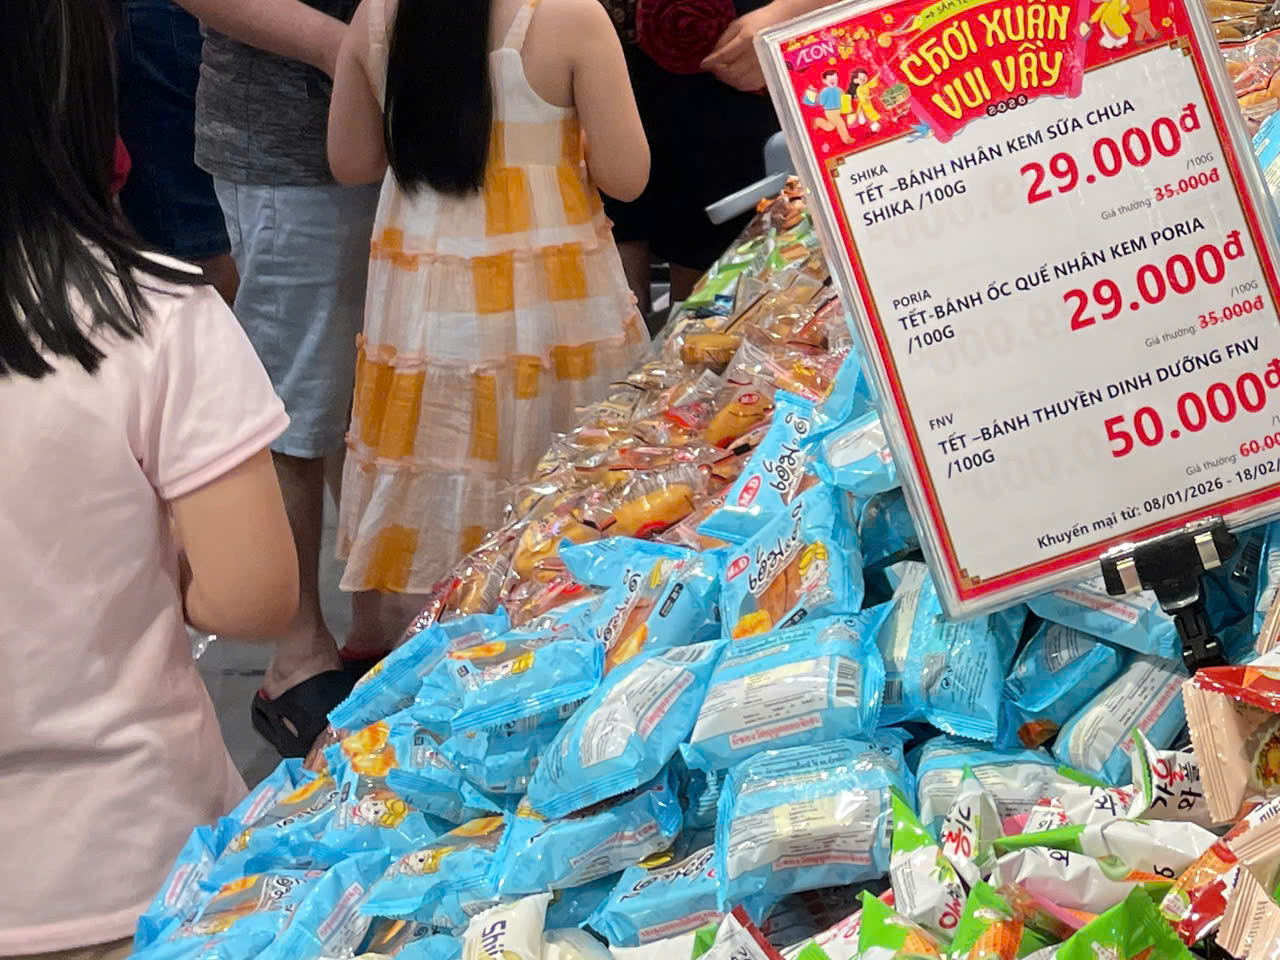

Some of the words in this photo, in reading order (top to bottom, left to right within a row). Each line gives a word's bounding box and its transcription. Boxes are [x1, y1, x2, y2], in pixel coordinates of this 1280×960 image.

[931, 67, 993, 120] VUI
[986, 94, 1029, 118] 2026
[849, 164, 889, 186] SHIKA
[855, 183, 885, 207] TẾT
[950, 145, 1003, 171] NHÂN
[1006, 130, 1046, 154] KEM
[1047, 115, 1085, 141] SỮA
[1020, 102, 1203, 206] 29.000đ
[1186, 152, 1215, 171] /100G
[862, 200, 915, 228] SHIKA
[918, 180, 968, 211] /100G
[1100, 206, 1119, 222] Giá
[1154, 170, 1221, 203] 35.000đ
[898, 291, 984, 332] TẾT-BÁNH
[986, 277, 1013, 301] ỐC
[1014, 264, 1052, 293] QUẾ
[1053, 248, 1107, 280] NHÂN
[1110, 235, 1148, 261] KEM
[1151, 216, 1206, 247] PORIA
[1062, 229, 1246, 332] 29.000đ
[1230, 279, 1259, 299] /100G
[892, 289, 932, 311] PORIA
[1144, 332, 1161, 348] Giá
[1198, 294, 1265, 330] 35.000đ
[907, 324, 956, 355] /100G
[938, 431, 968, 457] TẾT
[1032, 387, 1104, 425] THUYỀN
[1106, 373, 1153, 400] DINH
[1155, 348, 1223, 384] DƯỠNG
[1225, 336, 1261, 361] FNV
[928, 413, 955, 431] FNV
[946, 448, 996, 480] /100G
[1185, 460, 1202, 477] Giá
[1036, 522, 1090, 550] Khuyến
[1091, 512, 1118, 531] mại
[1120, 504, 1143, 522] từ:
[1143, 476, 1225, 514] 08/01/2026
